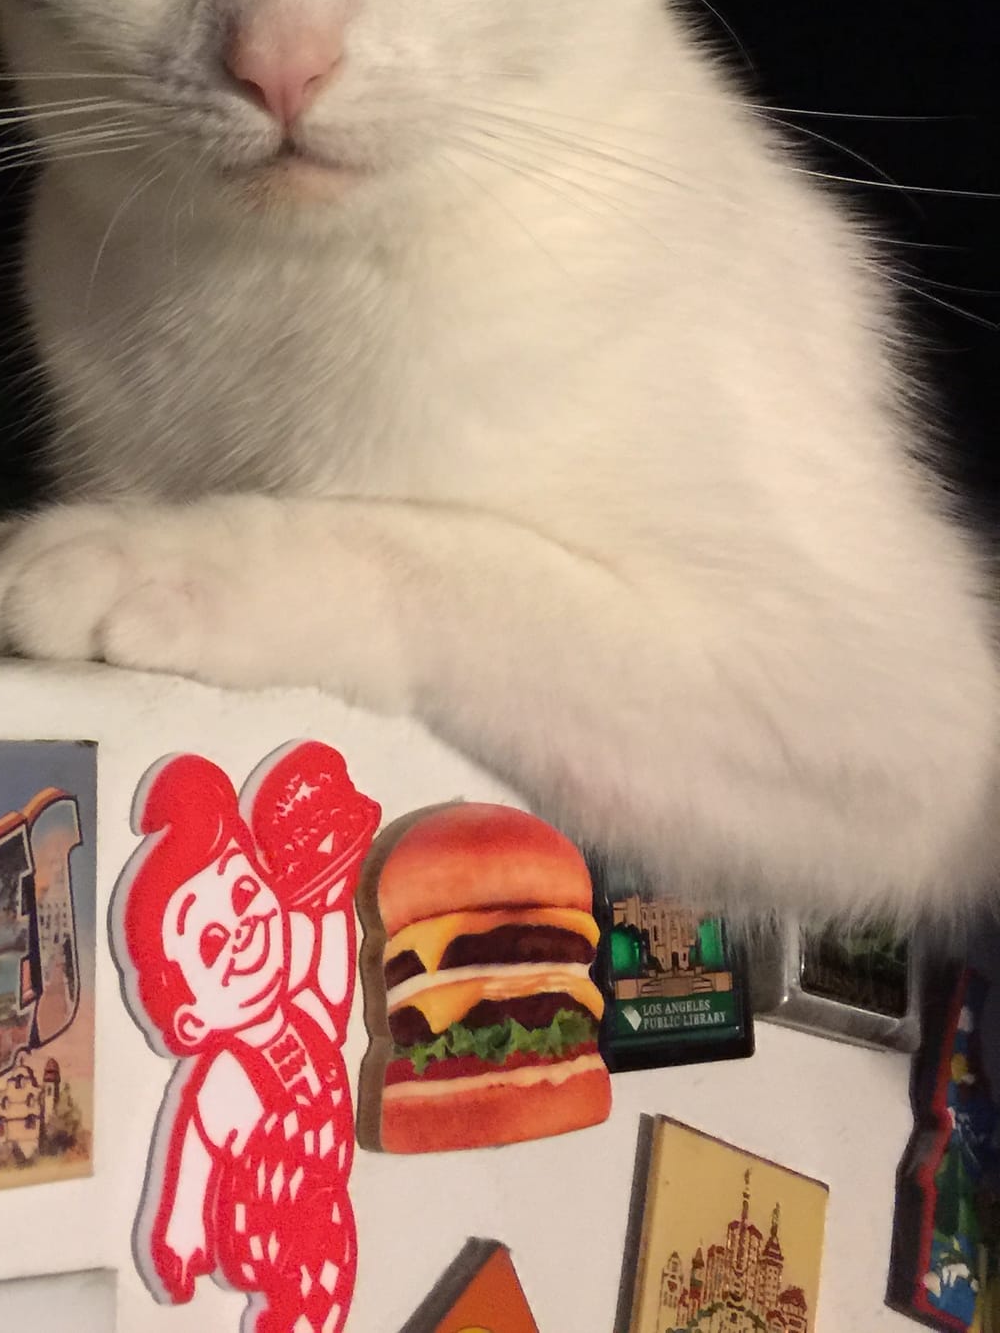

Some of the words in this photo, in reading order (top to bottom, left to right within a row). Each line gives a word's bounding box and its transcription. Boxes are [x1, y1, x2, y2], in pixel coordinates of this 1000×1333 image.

[642, 1002, 663, 1016] LOS
[665, 999, 712, 1015] ANGELES
[643, 1013, 681, 1030] PUBLIC
[683, 1011, 727, 1026] LIBRARY
